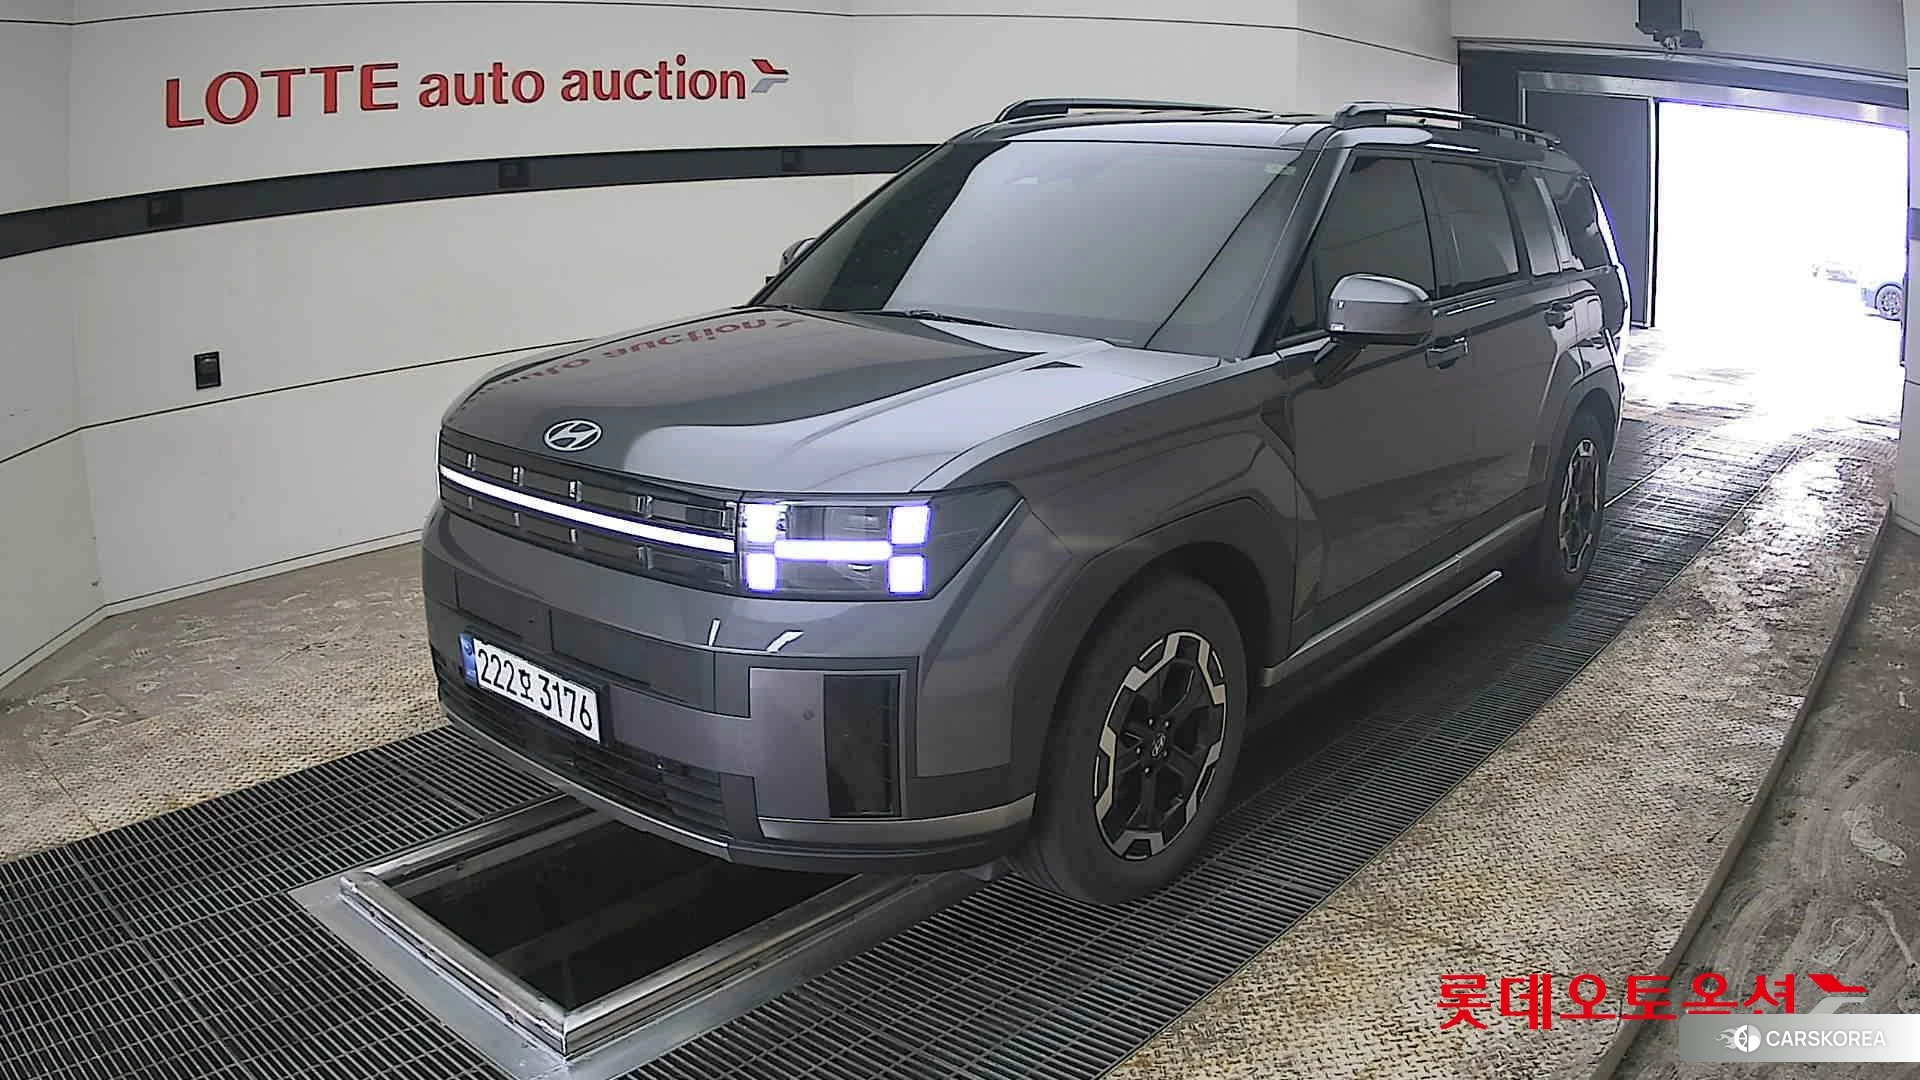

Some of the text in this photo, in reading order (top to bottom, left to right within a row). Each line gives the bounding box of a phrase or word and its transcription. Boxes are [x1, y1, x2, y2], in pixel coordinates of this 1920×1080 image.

[164, 54, 747, 130] LOTTE auto auction
[538, 673, 593, 731] 3176
